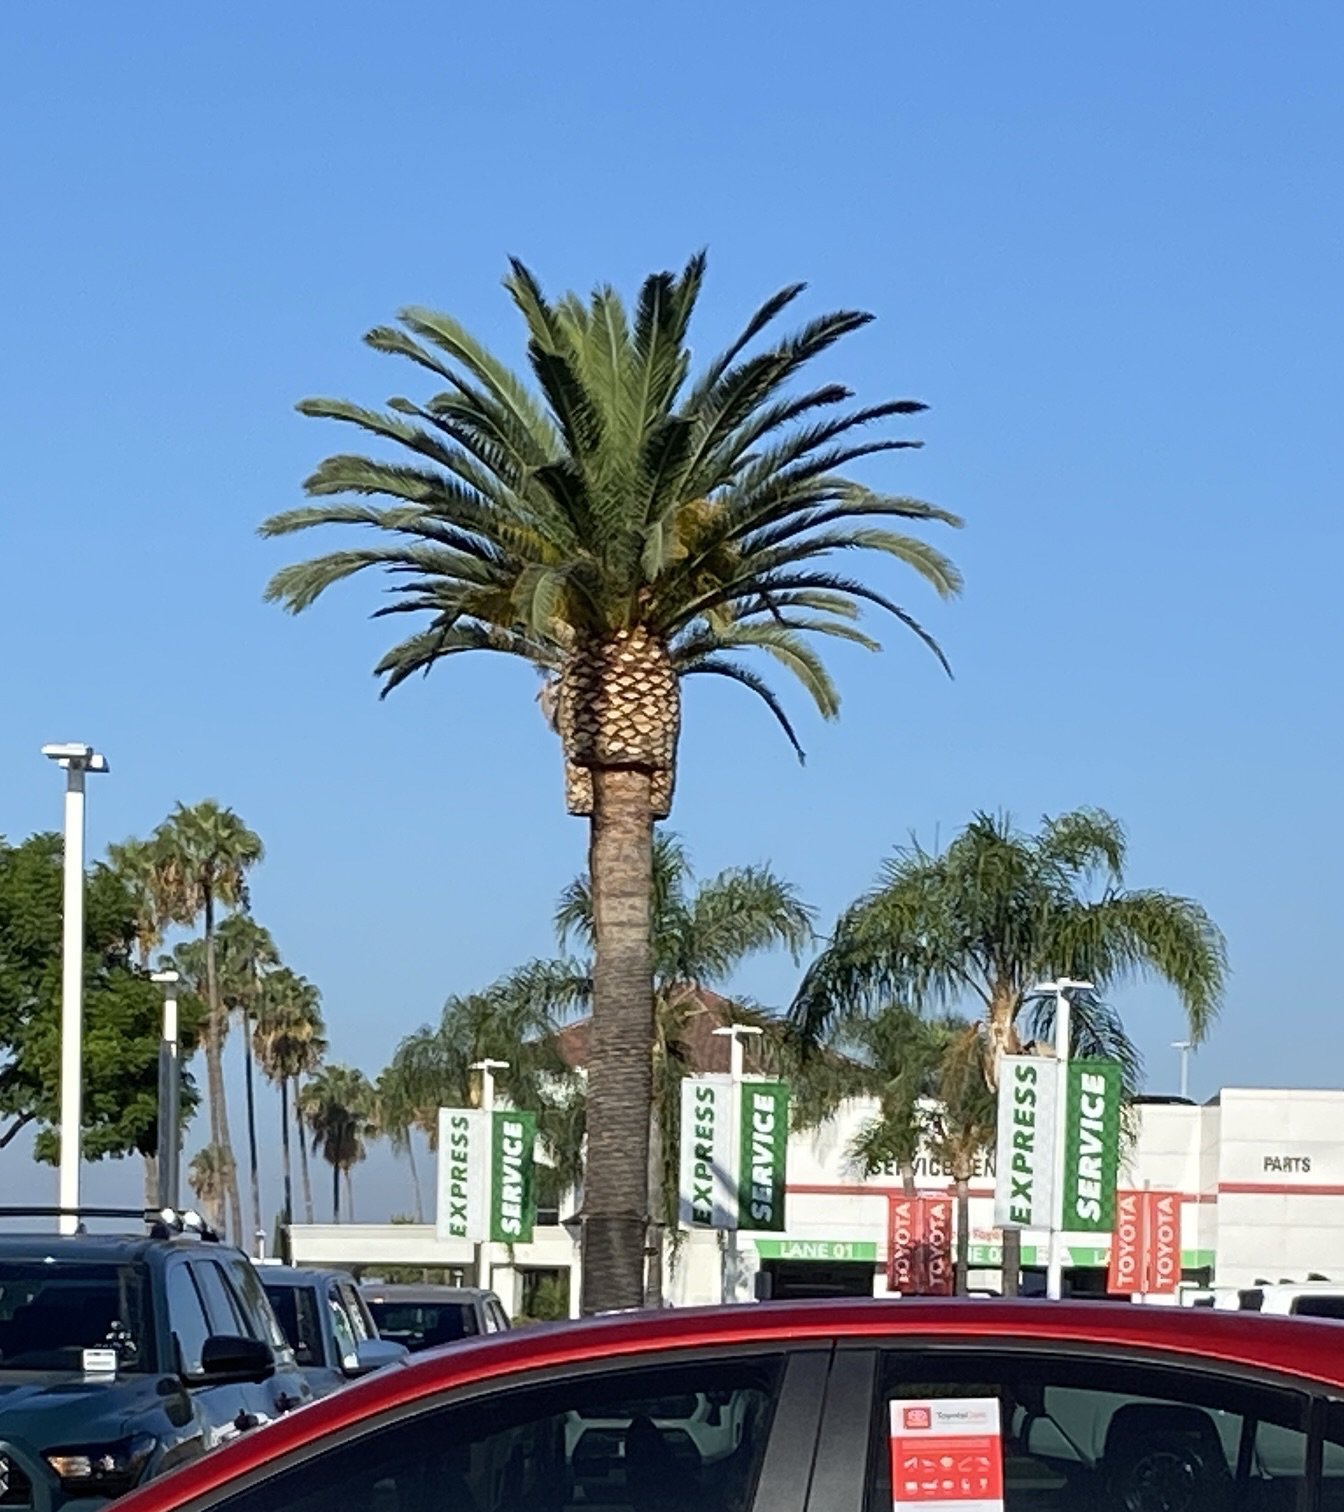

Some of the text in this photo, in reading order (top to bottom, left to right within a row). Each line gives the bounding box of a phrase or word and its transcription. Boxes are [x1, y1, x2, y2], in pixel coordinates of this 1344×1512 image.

[449, 1116, 470, 1238] EXPRESS
[500, 1121, 524, 1237] SERVICE
[692, 1086, 715, 1226] EXPRESS
[750, 1093, 775, 1223] SERVICE
[1010, 1064, 1037, 1226] EXPRESS
[1076, 1072, 1106, 1223] SERVICE
[1263, 1156, 1312, 1173] PARTS
[780, 1243, 854, 1259] LANE 01
[894, 1201, 911, 1287] TOYOTA
[929, 1203, 946, 1288] TOYOTA
[1116, 1195, 1137, 1288] TOYOTA
[1156, 1196, 1174, 1289] TOYOTA
